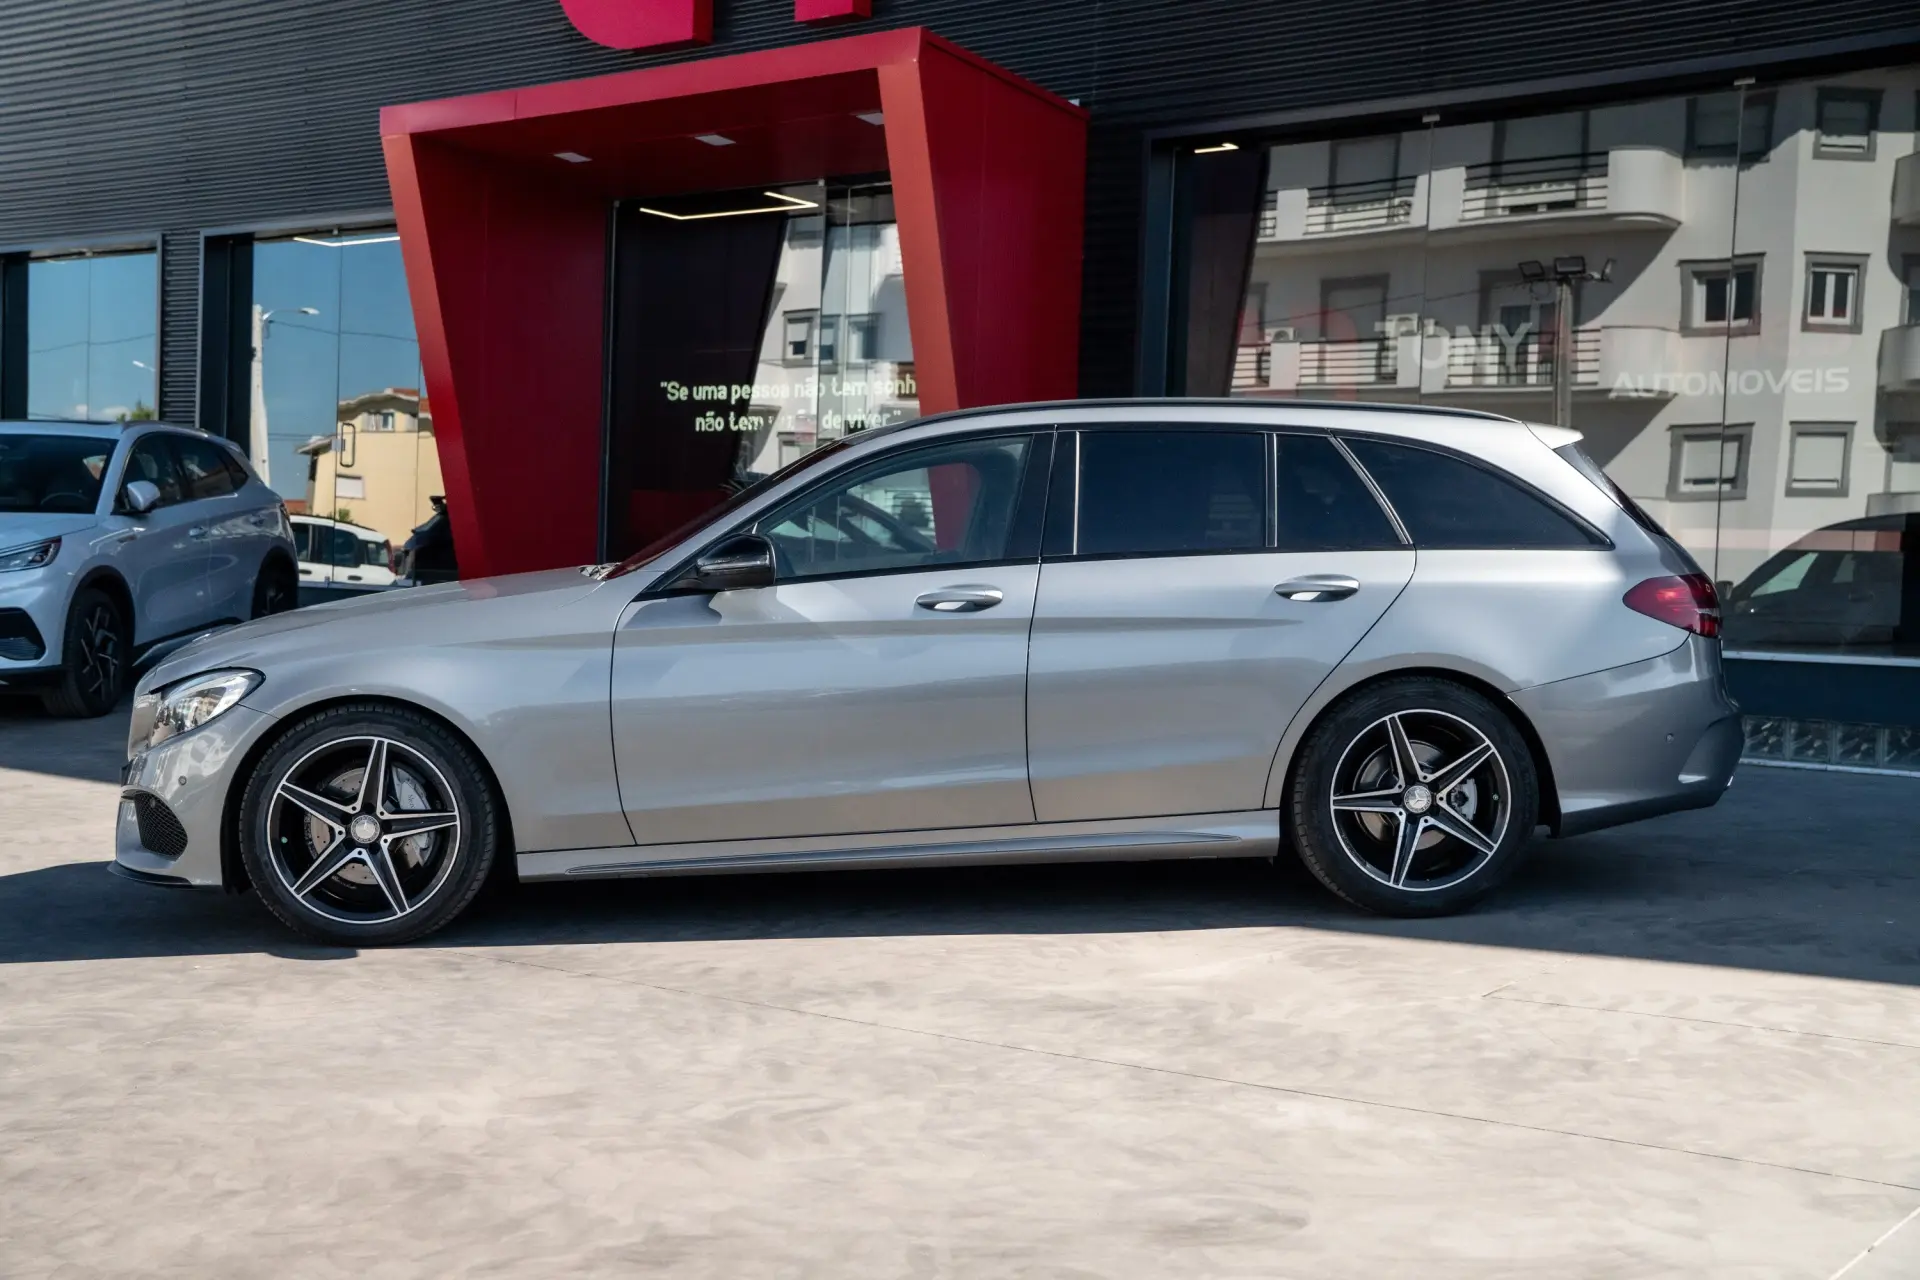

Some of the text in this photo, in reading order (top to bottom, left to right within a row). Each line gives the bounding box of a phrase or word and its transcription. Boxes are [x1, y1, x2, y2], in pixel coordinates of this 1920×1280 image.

[1374, 321, 1533, 374] TONY
[692, 385, 728, 401] uma
[731, 383, 790, 405] pessoa
[794, 377, 826, 399] não
[831, 377, 869, 397] tem
[1608, 367, 1850, 399] AUTOMOVEIS
[695, 410, 725, 432] não
[729, 411, 764, 432] tem
[822, 409, 842, 430] de
